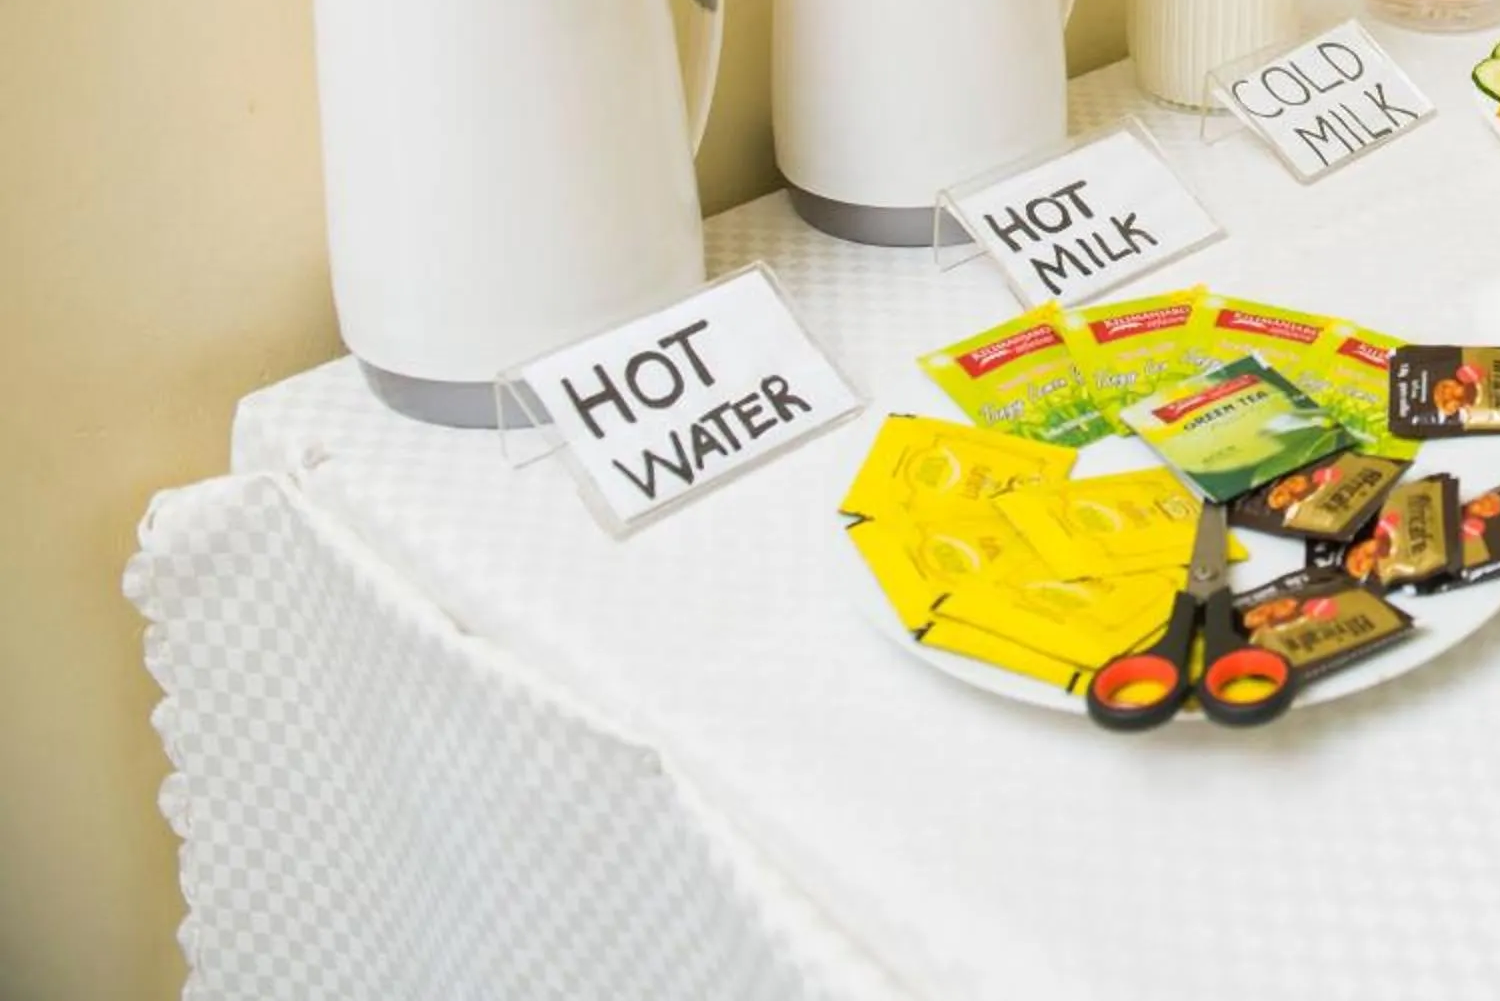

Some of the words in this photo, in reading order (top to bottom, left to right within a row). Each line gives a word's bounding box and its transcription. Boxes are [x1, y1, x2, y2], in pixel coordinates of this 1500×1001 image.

[1232, 42, 1364, 118] COLD
[1294, 83, 1419, 167] MILK
[983, 180, 1094, 253] HOT
[1029, 212, 1158, 296] MILK
[560, 319, 715, 439] HOT
[1183, 403, 1236, 431] GREEN
[1239, 389, 1270, 407] TEA
[611, 374, 812, 500] WATER
